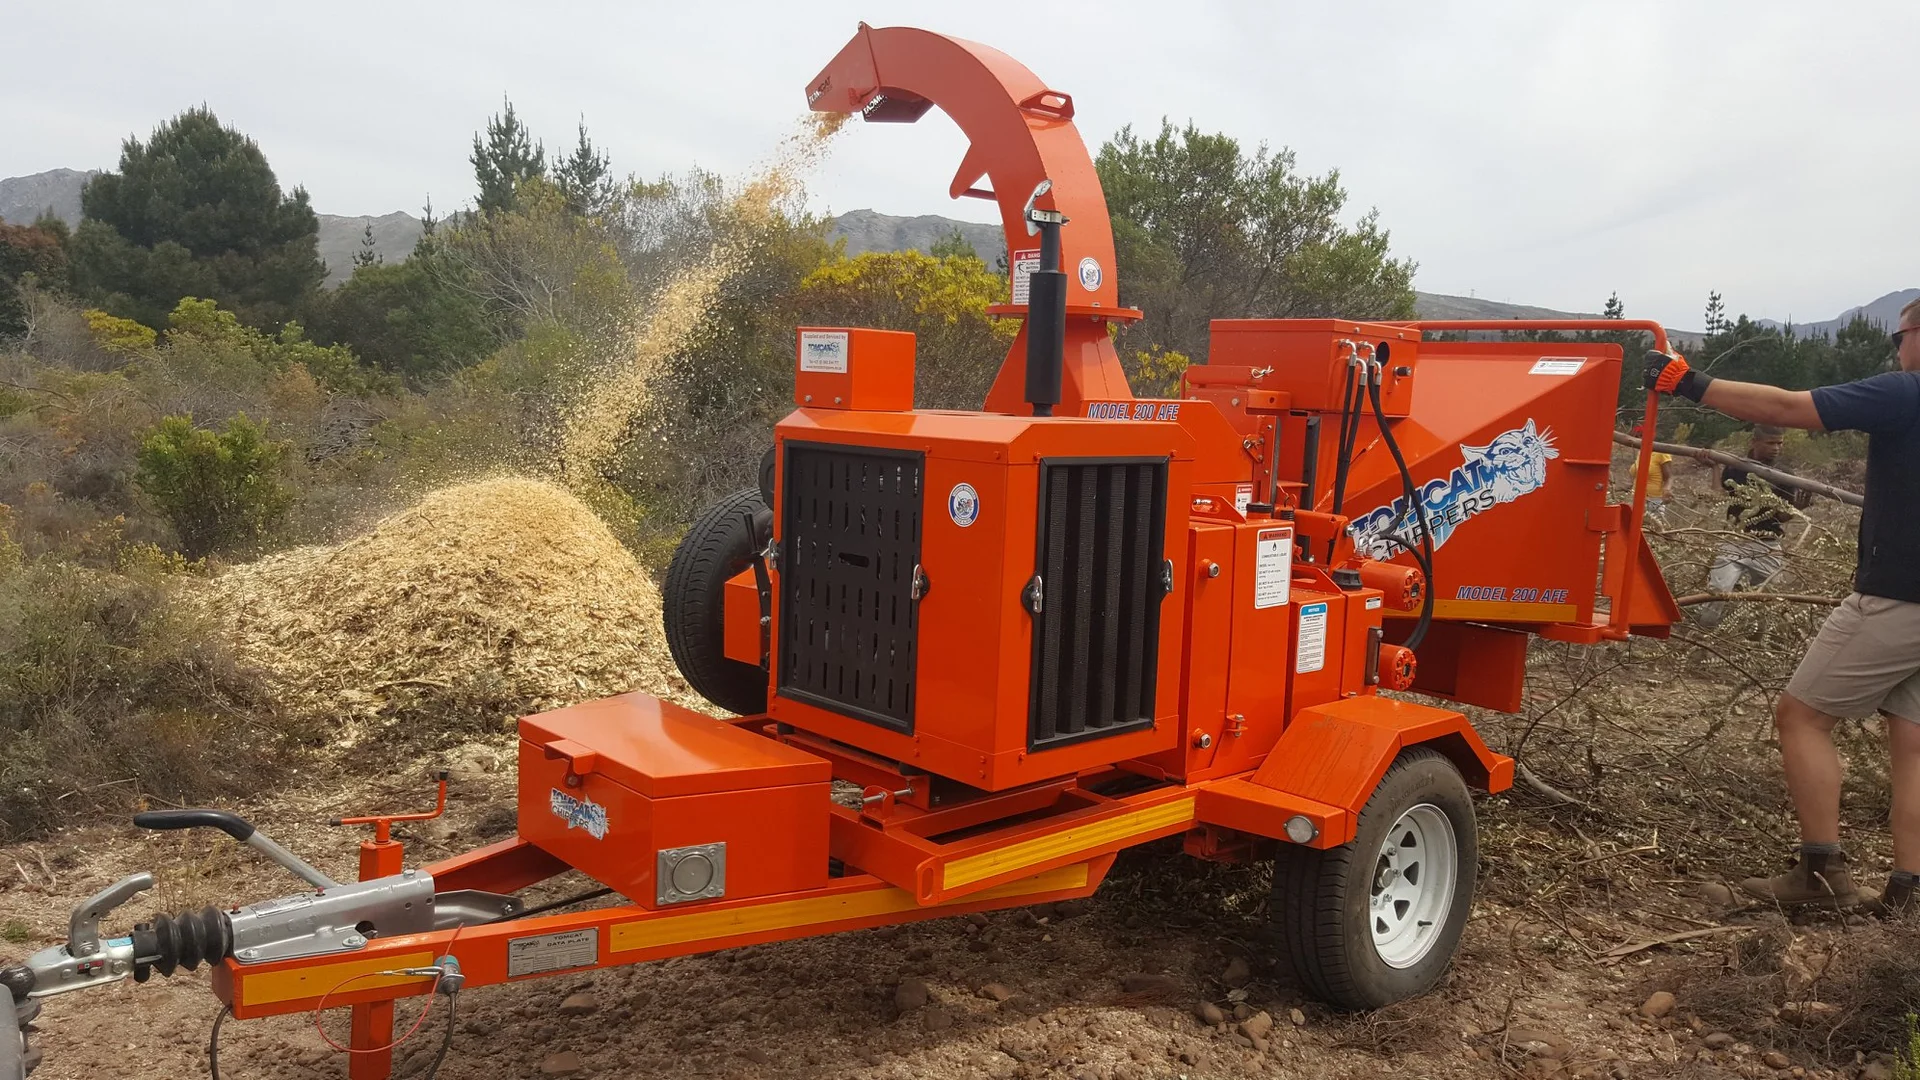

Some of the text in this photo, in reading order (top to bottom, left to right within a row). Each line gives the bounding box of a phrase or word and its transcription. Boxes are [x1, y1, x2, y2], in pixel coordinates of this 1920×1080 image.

[1087, 402, 1179, 420] MODEL 200 AFE
[1351, 458, 1484, 535] TOMCAT
[1456, 586, 1568, 603] MODEL 200 AFE
[551, 788, 591, 819] TOMCAT
[551, 805, 589, 830] CHIPPERS
[553, 932, 583, 940] TOMCAT
